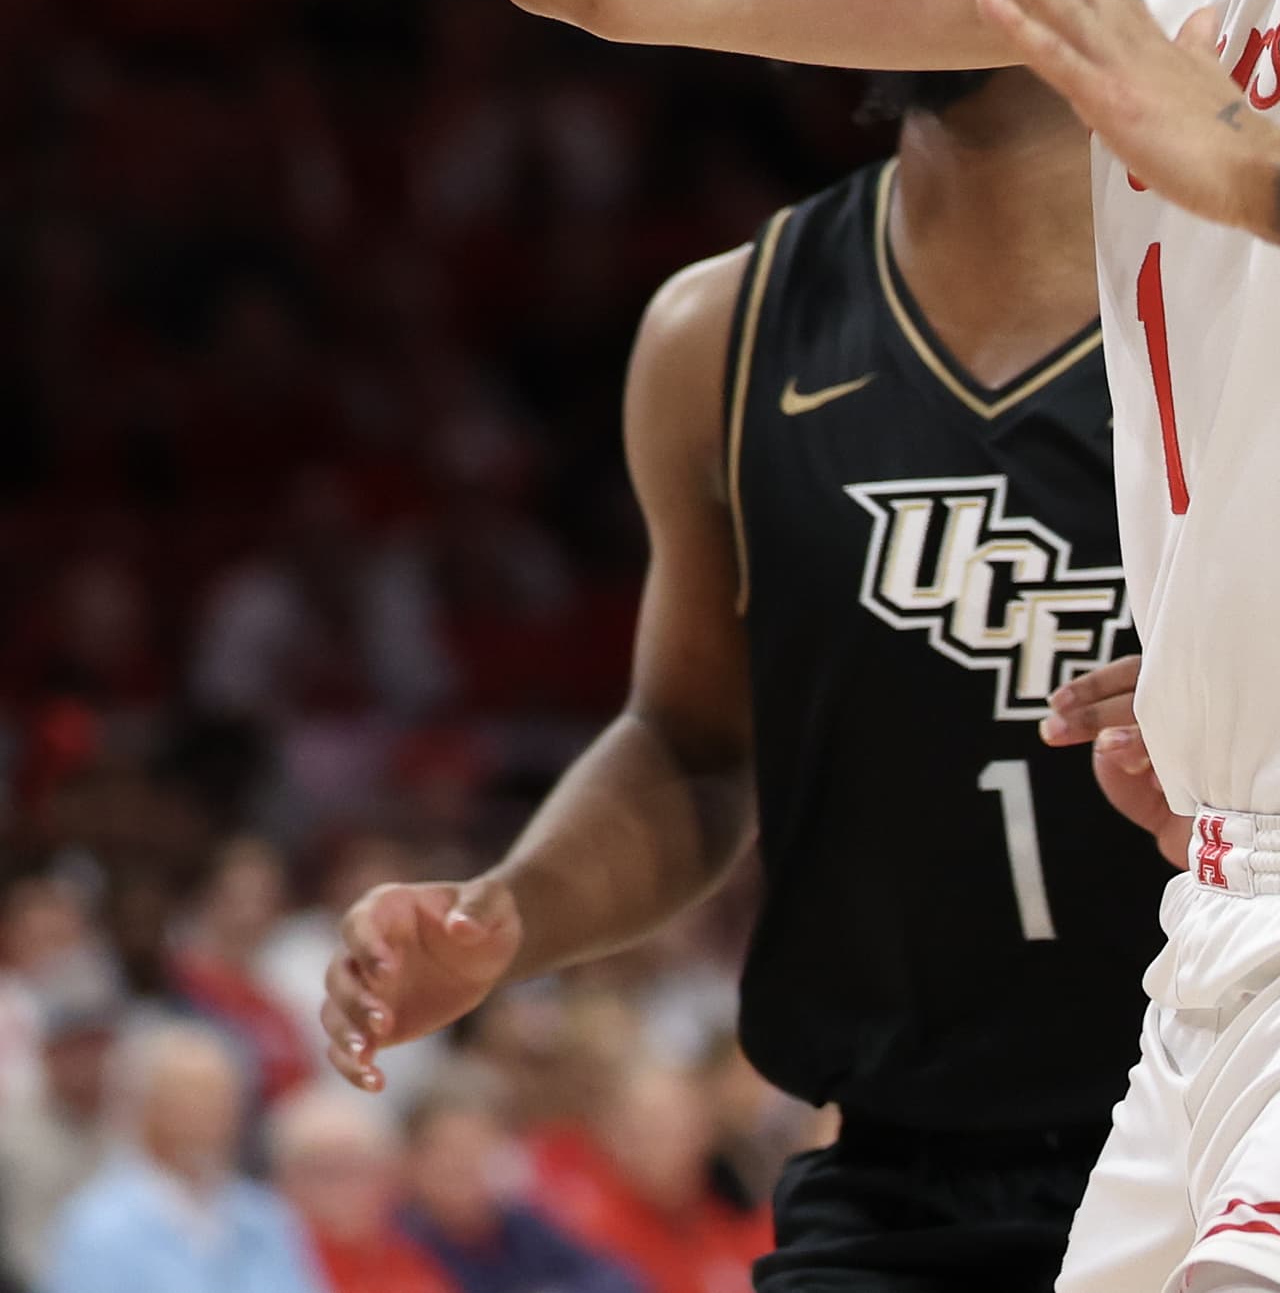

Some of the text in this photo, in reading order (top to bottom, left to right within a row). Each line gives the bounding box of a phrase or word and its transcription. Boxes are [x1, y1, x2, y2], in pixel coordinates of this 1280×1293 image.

[1136, 242, 1190, 515] 1
[858, 484, 1126, 711] UCF
[977, 759, 1058, 941] 1
